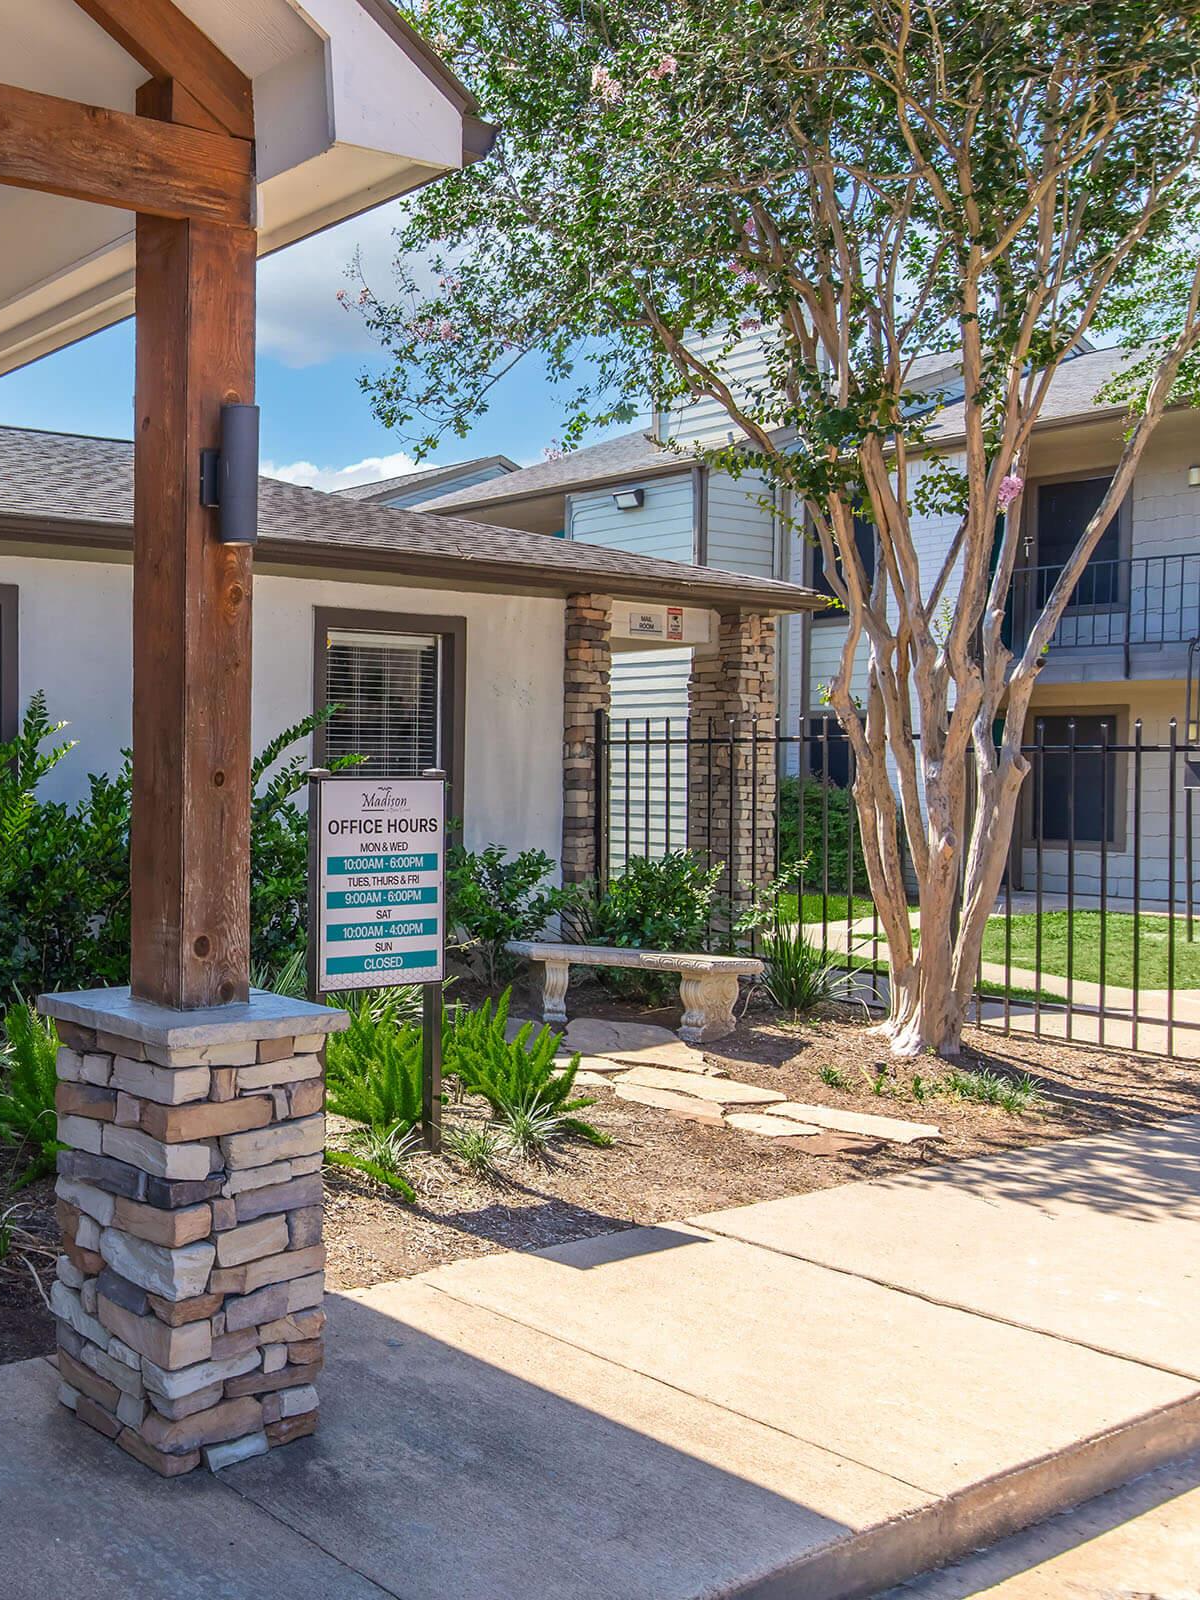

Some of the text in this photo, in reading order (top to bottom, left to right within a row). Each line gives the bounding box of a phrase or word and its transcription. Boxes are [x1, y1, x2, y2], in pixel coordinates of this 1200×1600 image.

[362, 790, 407, 807] Madison
[328, 818, 438, 835] OFFICE HOURS
[360, 841, 409, 852] MON & WED
[344, 858, 383, 870] 10:00AM
[390, 856, 424, 868] 6:00PM
[347, 875, 419, 887] TUES, THURS & FRI
[345, 892, 381, 905] 9:00AM
[388, 890, 421, 902] 6:00PM
[376, 909, 392, 919] SAT
[343, 926, 383, 938] 10:00AM
[389, 923, 423, 935] 4:00PM
[375, 942, 393, 952] SUN
[364, 956, 403, 970] CLOSED
